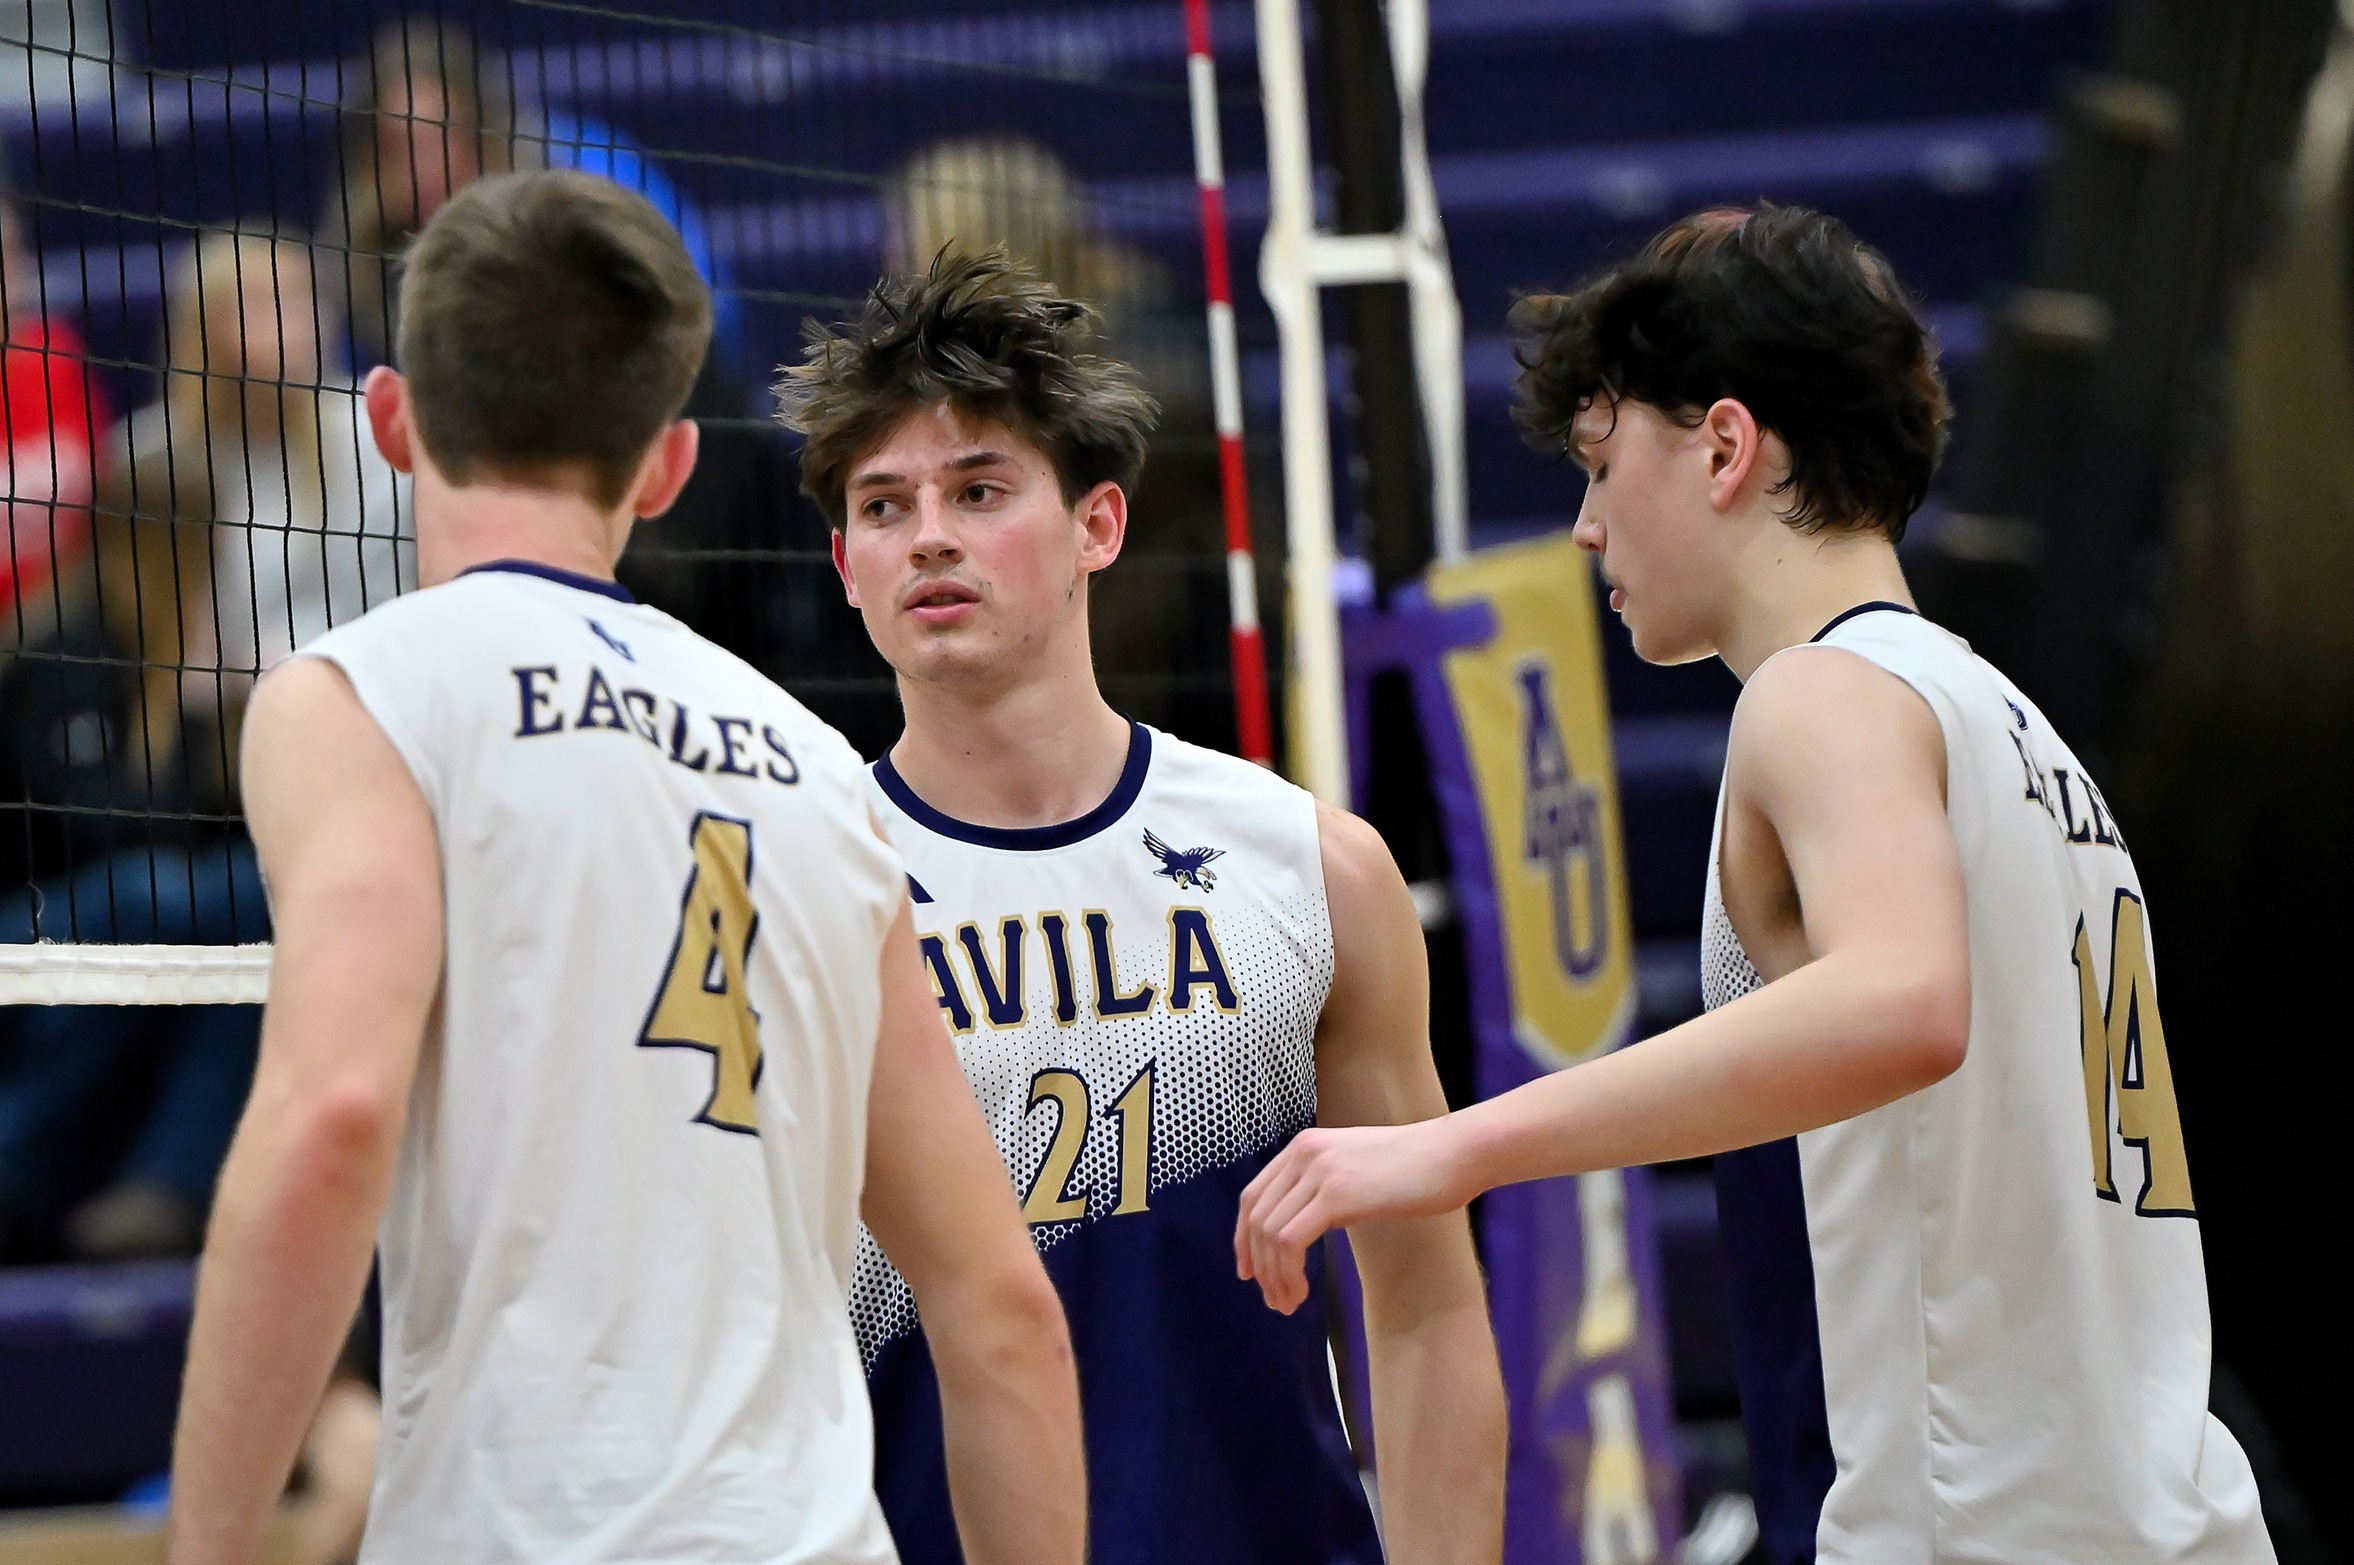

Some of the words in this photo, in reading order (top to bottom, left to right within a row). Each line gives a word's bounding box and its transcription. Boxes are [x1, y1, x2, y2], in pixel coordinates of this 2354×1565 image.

[511, 664, 801, 786] EAGLES
[635, 808, 764, 1138] 4
[919, 904, 1243, 1038] AVILA
[2071, 886, 2199, 1221] 14
[1023, 1056, 1158, 1228] 21
